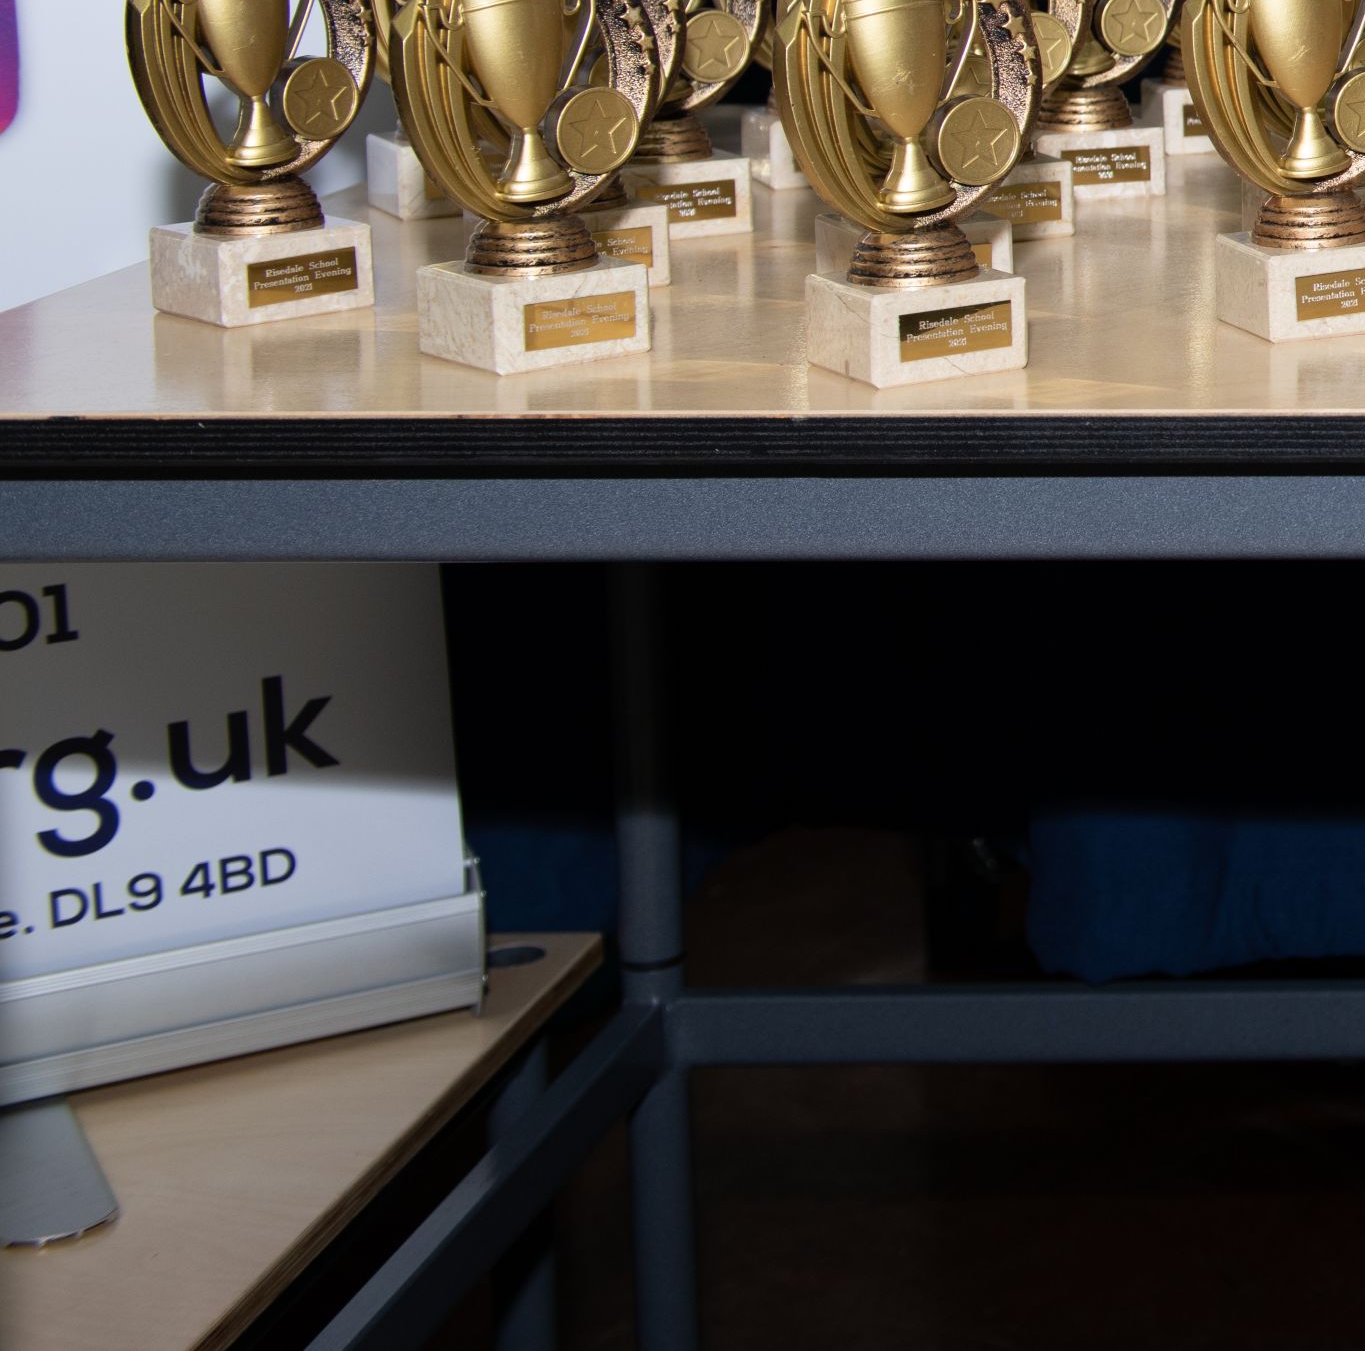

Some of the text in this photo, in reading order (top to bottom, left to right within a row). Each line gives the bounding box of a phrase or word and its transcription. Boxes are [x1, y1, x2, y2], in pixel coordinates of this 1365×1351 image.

[266, 258, 338, 277] Risedale School
[254, 268, 351, 289] Presentation Evening
[295, 283, 312, 292] 2021
[1313, 280, 1350, 291] Risedale
[1302, 290, 1355, 303] Presentation
[586, 303, 616, 313] School
[1341, 299, 1358, 308] 2021
[592, 313, 629, 324] Evening
[919, 312, 994, 330] Risedale School
[907, 322, 1007, 343] Presentation Evening
[49, 872, 163, 929] DL9
[179, 847, 297, 898] 4BD
